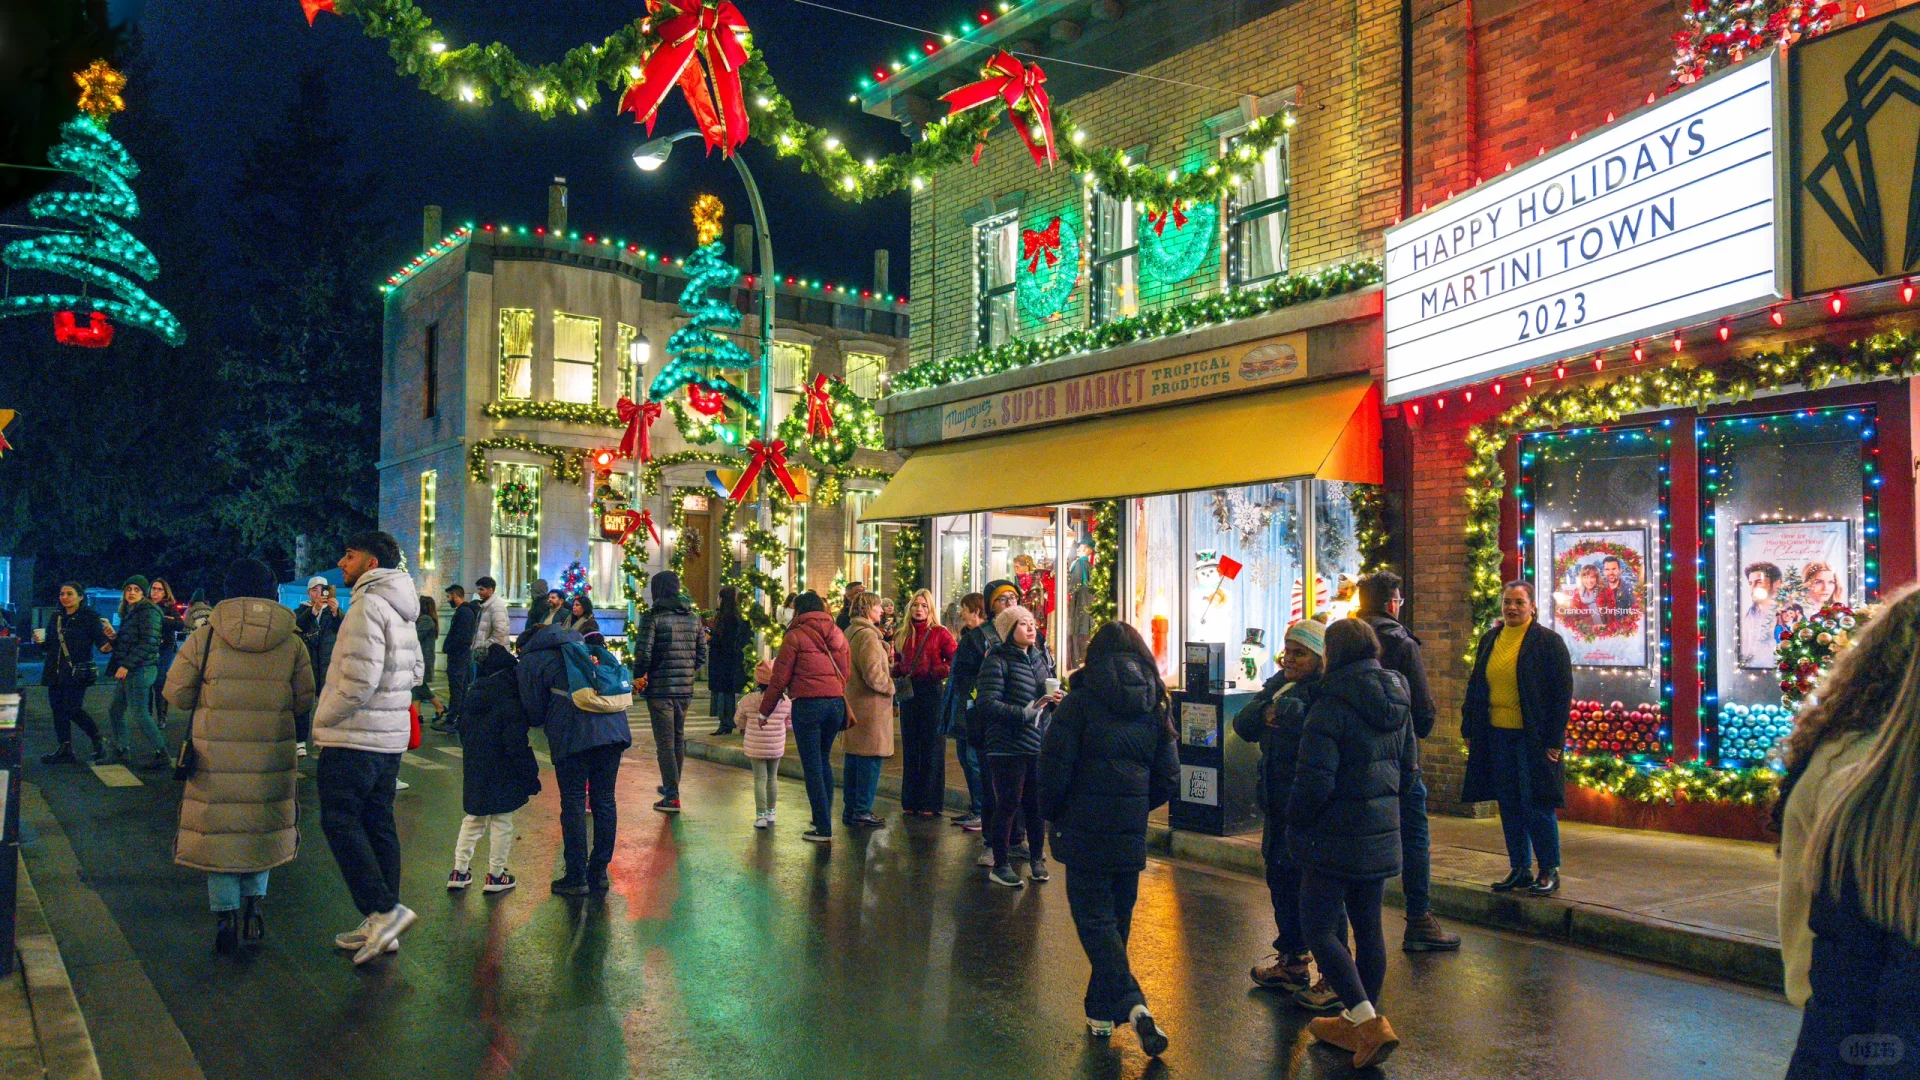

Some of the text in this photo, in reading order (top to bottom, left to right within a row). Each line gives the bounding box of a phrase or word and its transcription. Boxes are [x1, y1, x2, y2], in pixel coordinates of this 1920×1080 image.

[1412, 117, 1706, 271] HAPPY HOLIDAYS
[1420, 196, 1676, 319] MARTINI TOWN
[1517, 291, 1587, 341] 2023
[1151, 355, 1231, 381] TROPICAL
[1001, 368, 1146, 425] SUPER MARKET
[1151, 370, 1232, 397] PRODUCTS
[945, 398, 993, 433] Mayaguez
[982, 417, 997, 429] 234
[1557, 606, 1641, 617] Cranberry Christmas
[1190, 779, 1208, 789] YORK
[1191, 770, 1208, 781] NEW
[1189, 788, 1208, 798] POST
